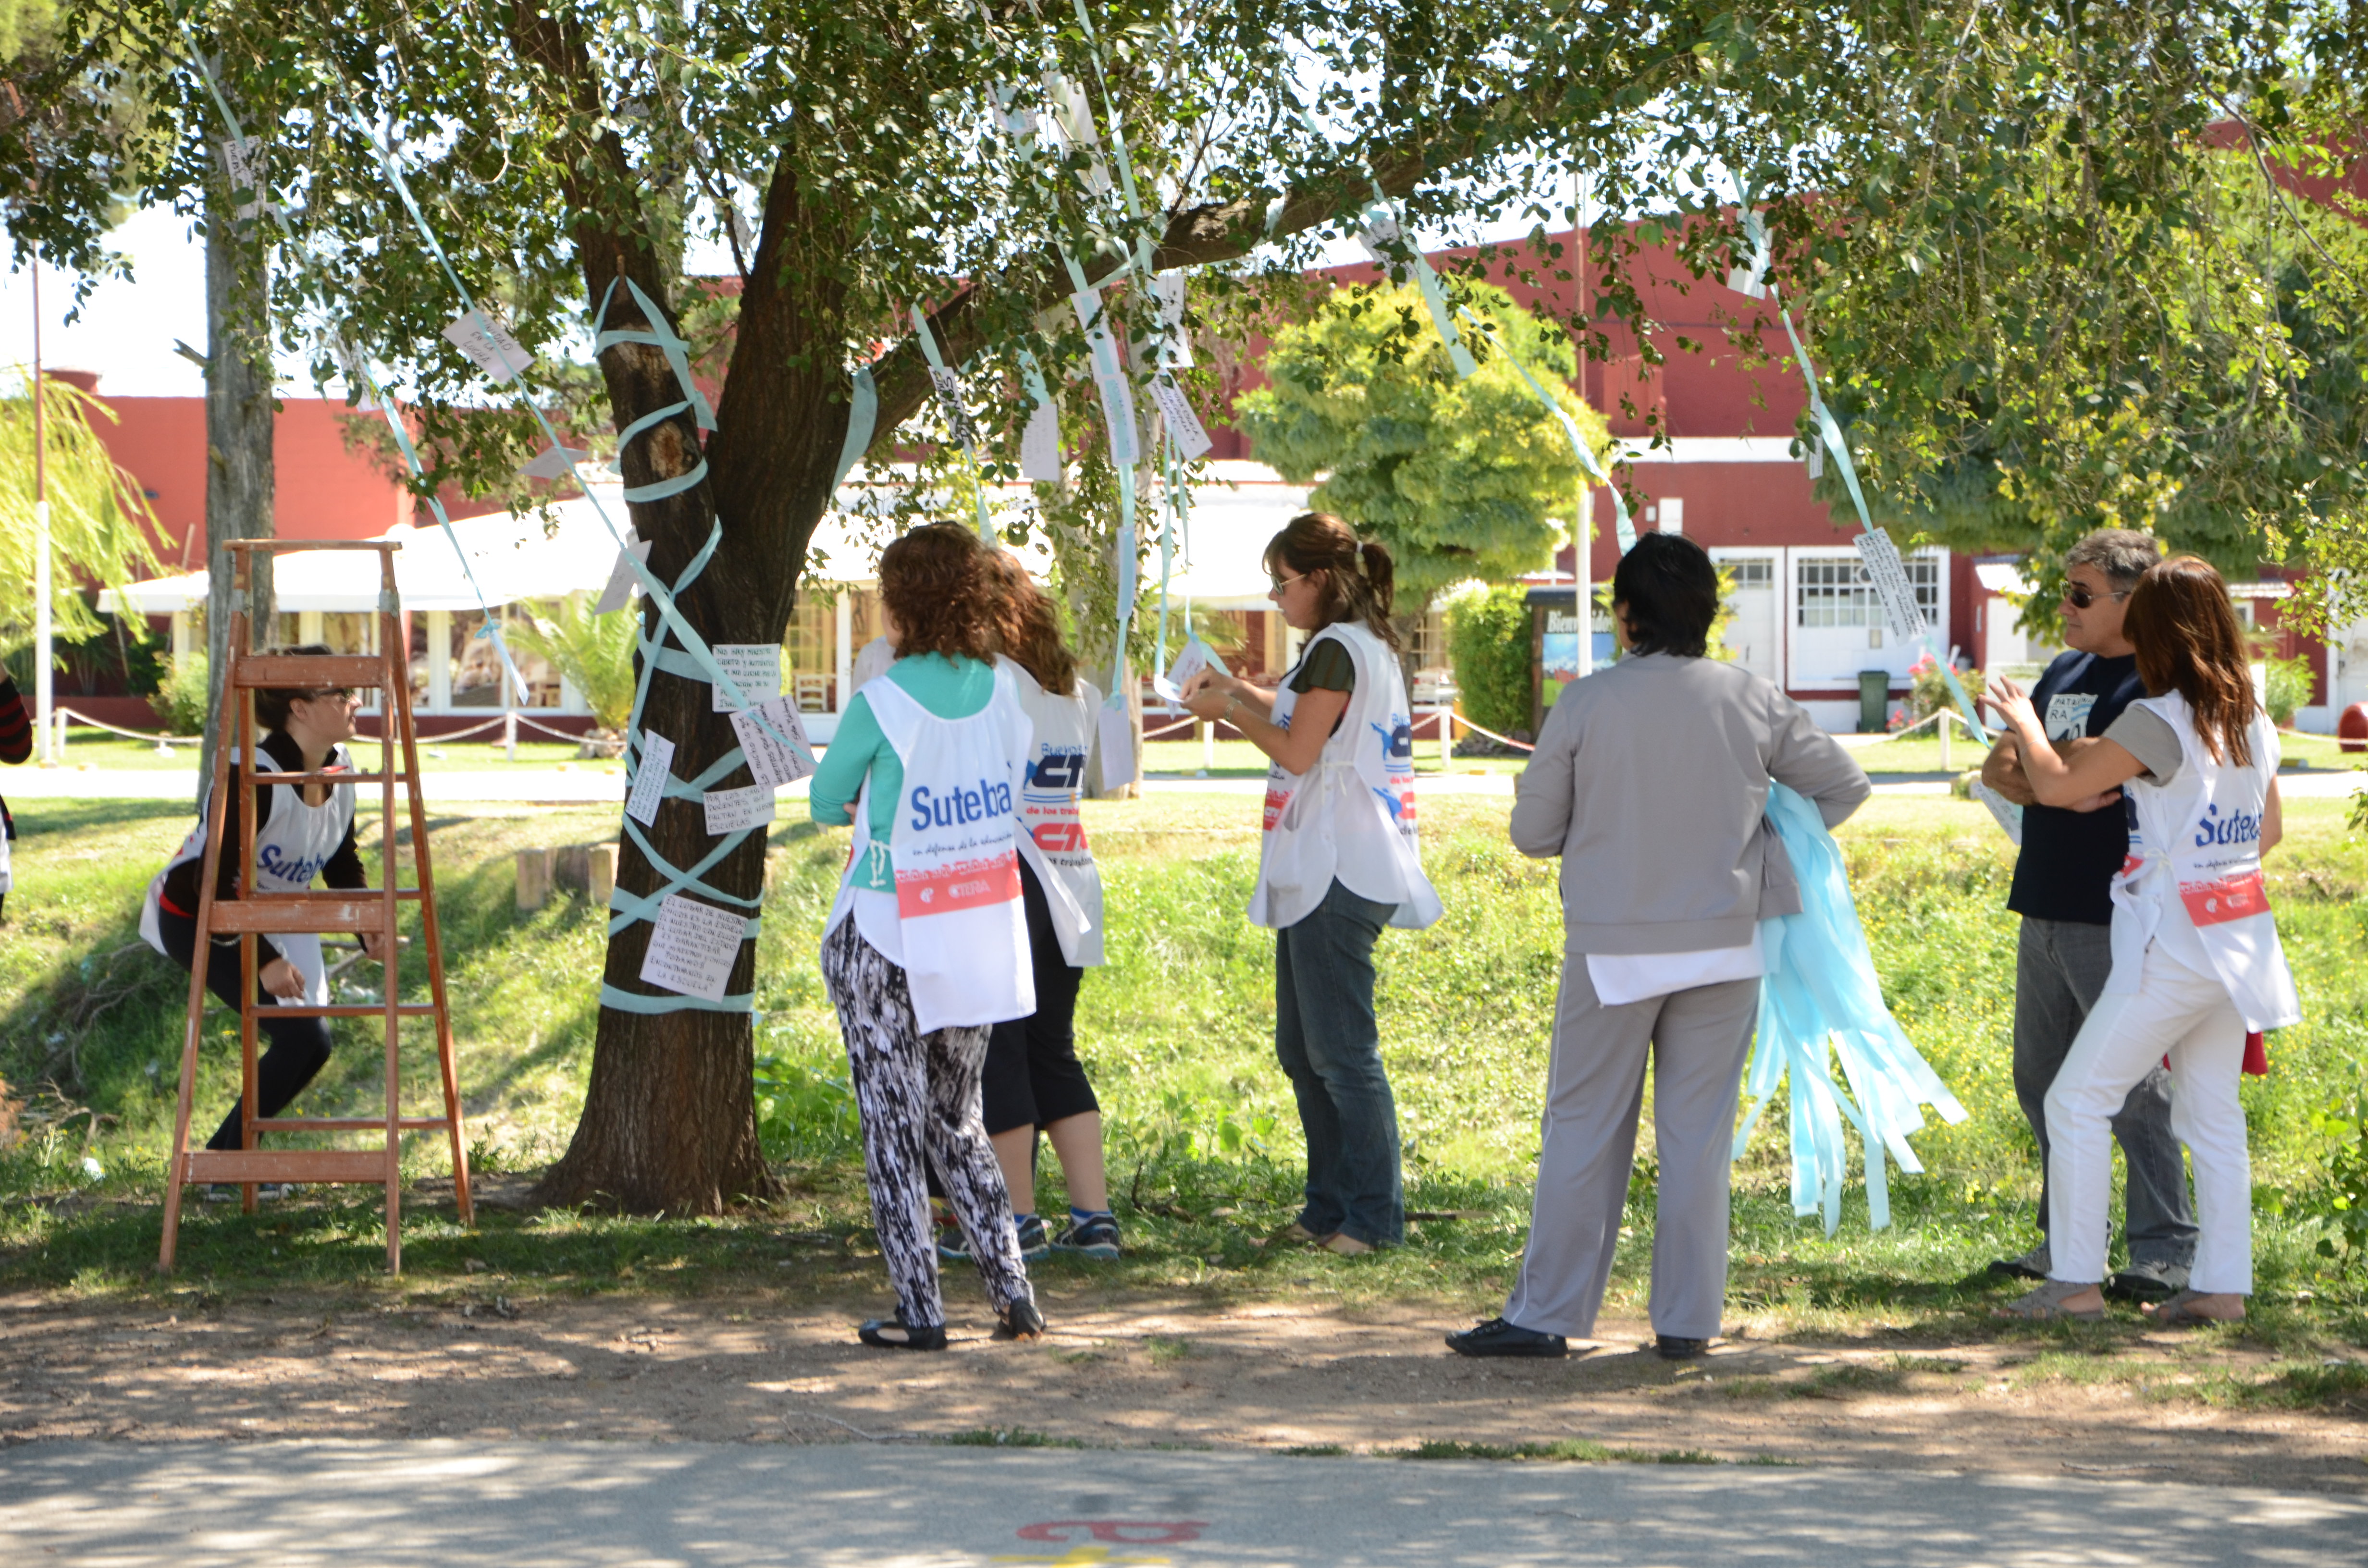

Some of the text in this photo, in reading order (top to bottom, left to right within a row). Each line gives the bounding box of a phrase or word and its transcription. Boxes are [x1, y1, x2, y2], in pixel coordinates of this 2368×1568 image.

[2050, 710, 2067, 719] RA
[724, 792, 740, 800] LOS
[707, 799, 748, 811] DOCENTES
[911, 778, 1012, 832] Suteba
[1026, 806, 1039, 815] de
[1043, 806, 1057, 815] los
[707, 811, 737, 821] FALTAN
[709, 819, 750, 831] ESCUELAS
[678, 901, 703, 914] LUGAR
